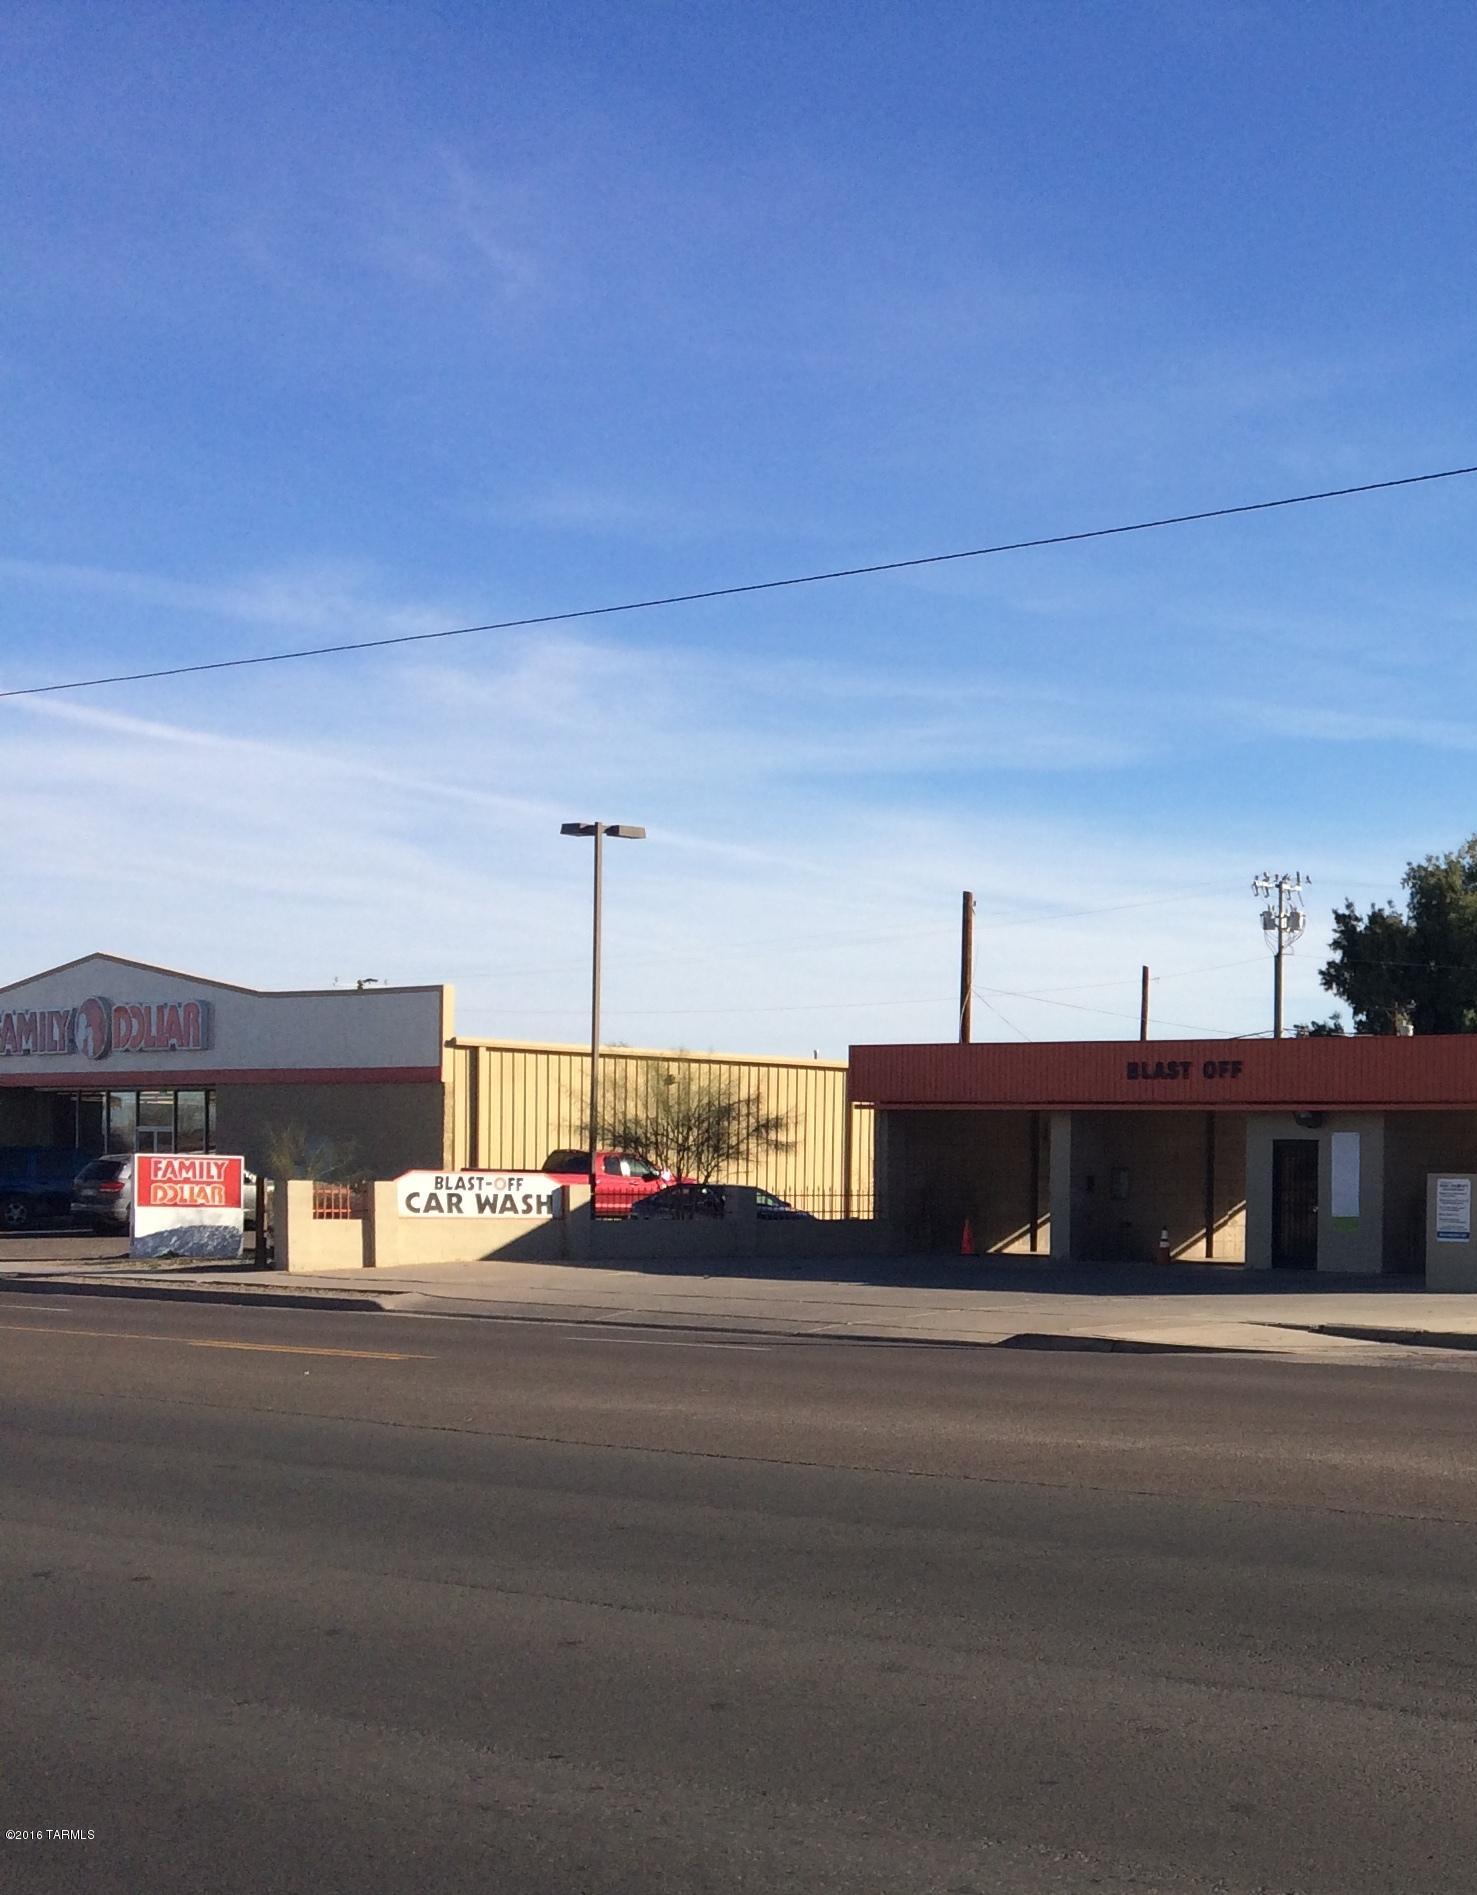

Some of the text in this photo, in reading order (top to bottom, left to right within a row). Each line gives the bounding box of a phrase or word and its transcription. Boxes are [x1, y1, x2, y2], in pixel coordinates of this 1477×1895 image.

[0, 1001, 202, 1054] AMILY DOLLAR
[1127, 1060, 1243, 1080] BLAST OFF
[150, 1158, 230, 1181] FAMILY
[150, 1182, 227, 1206] DOLLAR
[434, 1175, 524, 1191] BLAST-OFF
[405, 1191, 553, 1215] CAR WASH
